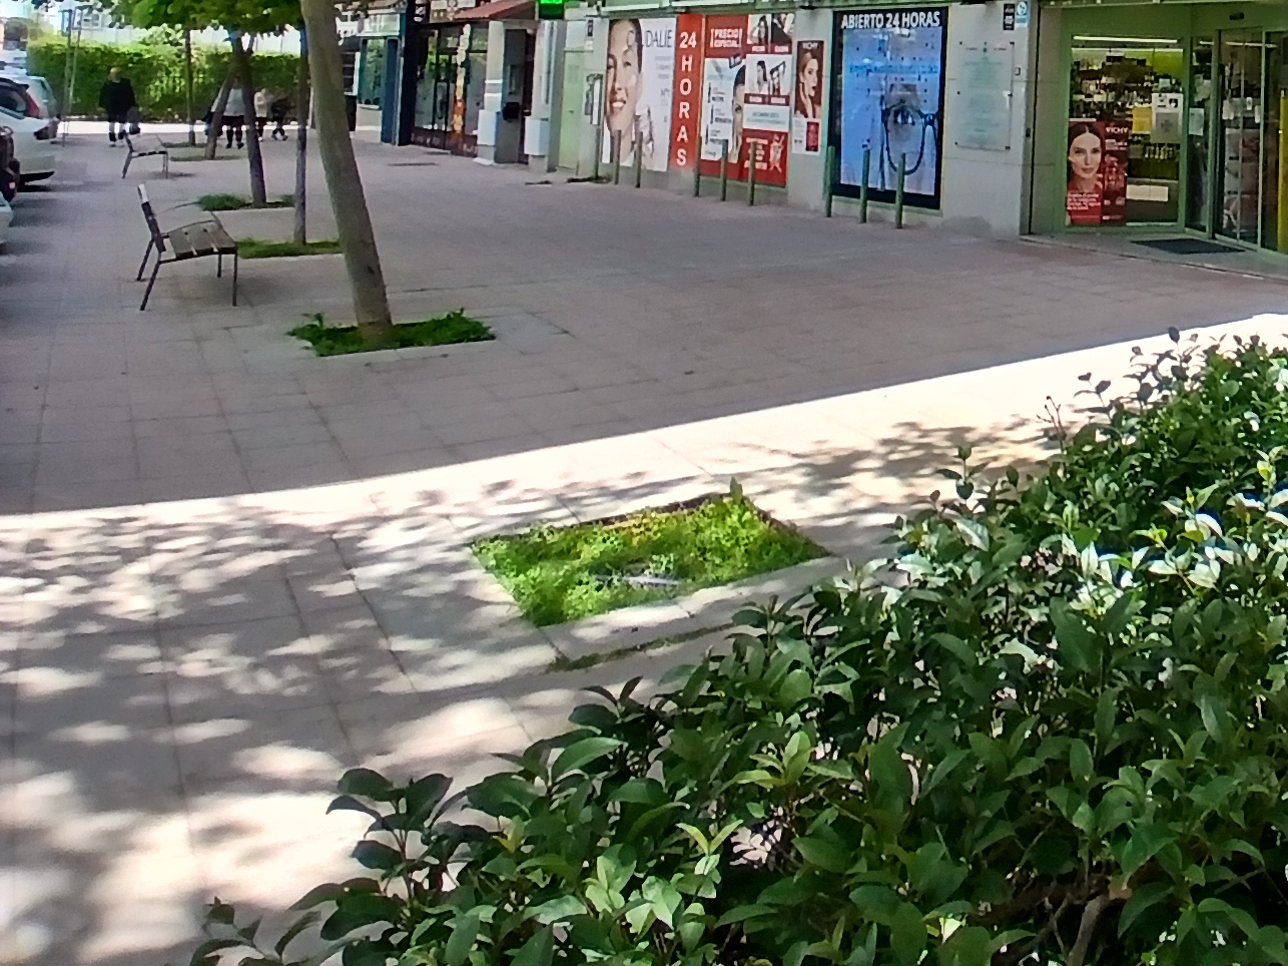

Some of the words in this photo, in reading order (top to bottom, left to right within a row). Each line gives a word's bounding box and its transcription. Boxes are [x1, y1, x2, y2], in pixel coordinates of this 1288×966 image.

[841, 13, 884, 30] ABIERTO
[885, 12, 900, 29] 24
[902, 11, 941, 28] HORAS
[679, 31, 697, 49] 24
